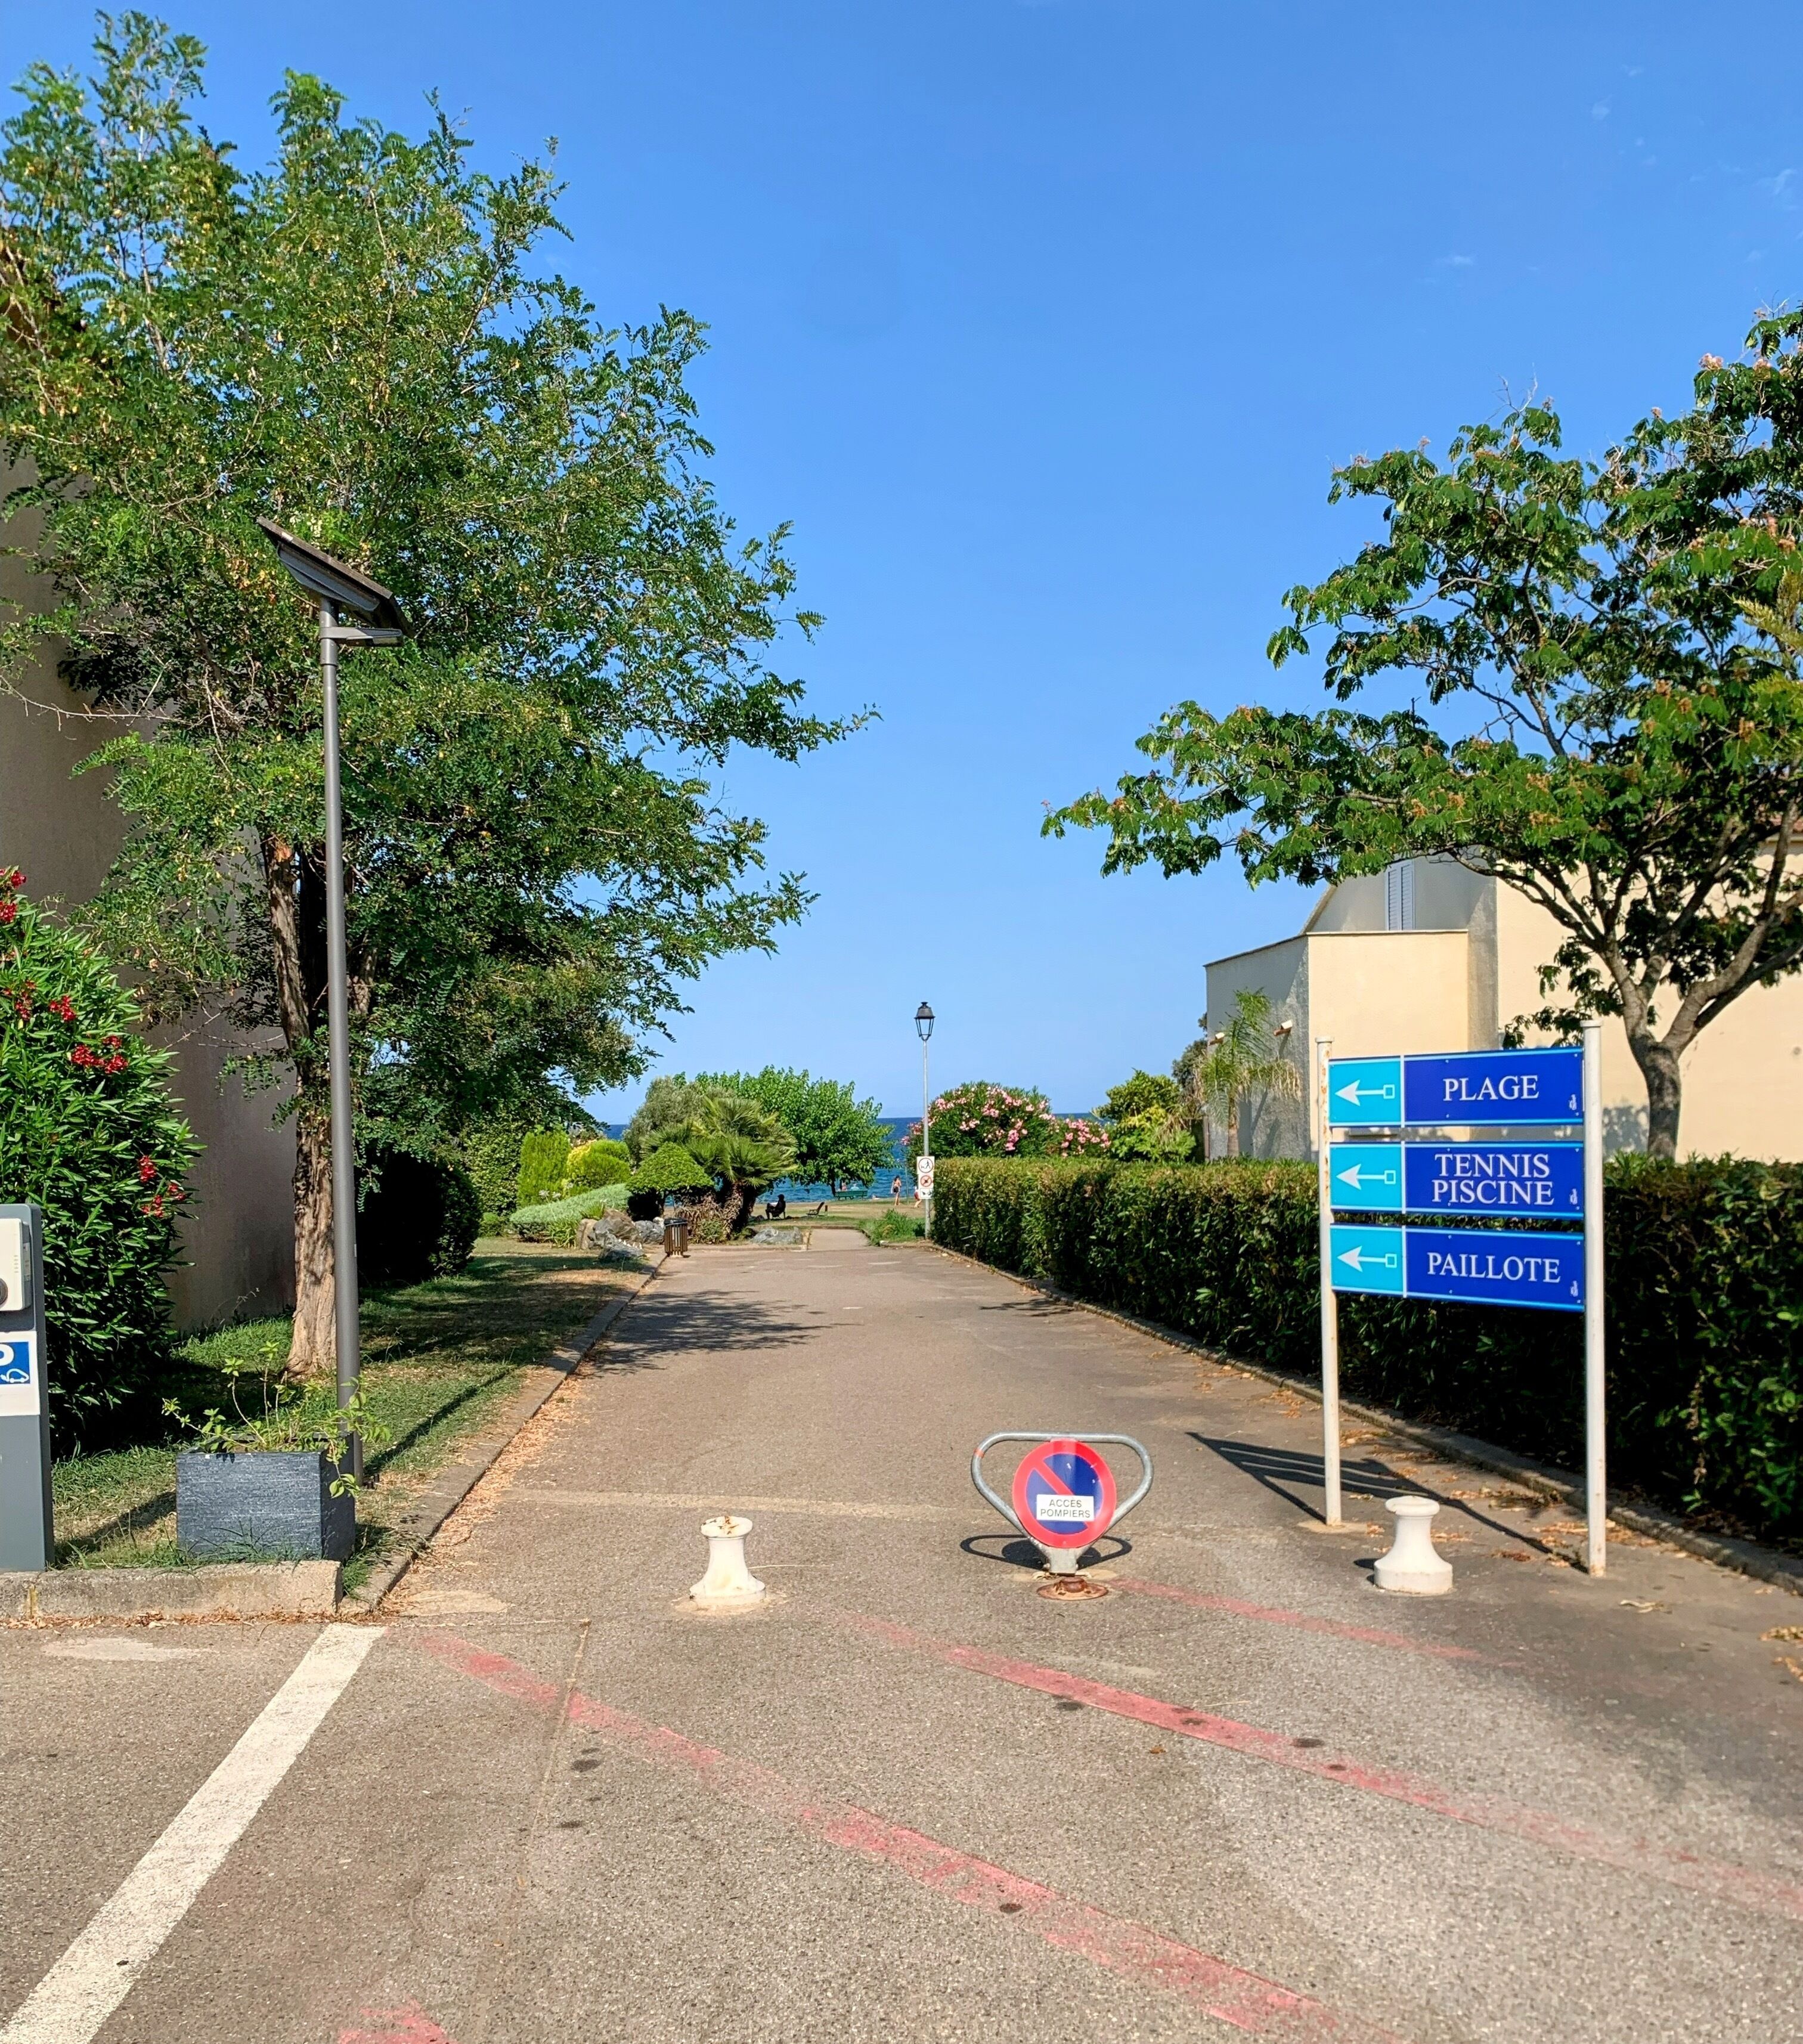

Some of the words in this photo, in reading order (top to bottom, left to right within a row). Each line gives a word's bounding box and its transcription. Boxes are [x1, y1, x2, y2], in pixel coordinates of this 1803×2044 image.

[1442, 1074, 1540, 1102] PLAGE
[1434, 1153, 1551, 1178] TENNIS
[1431, 1179, 1555, 1205] PISCINE
[1427, 1252, 1562, 1283] PAILLOTE
[1040, 1509, 1091, 1518] POMPIERS
